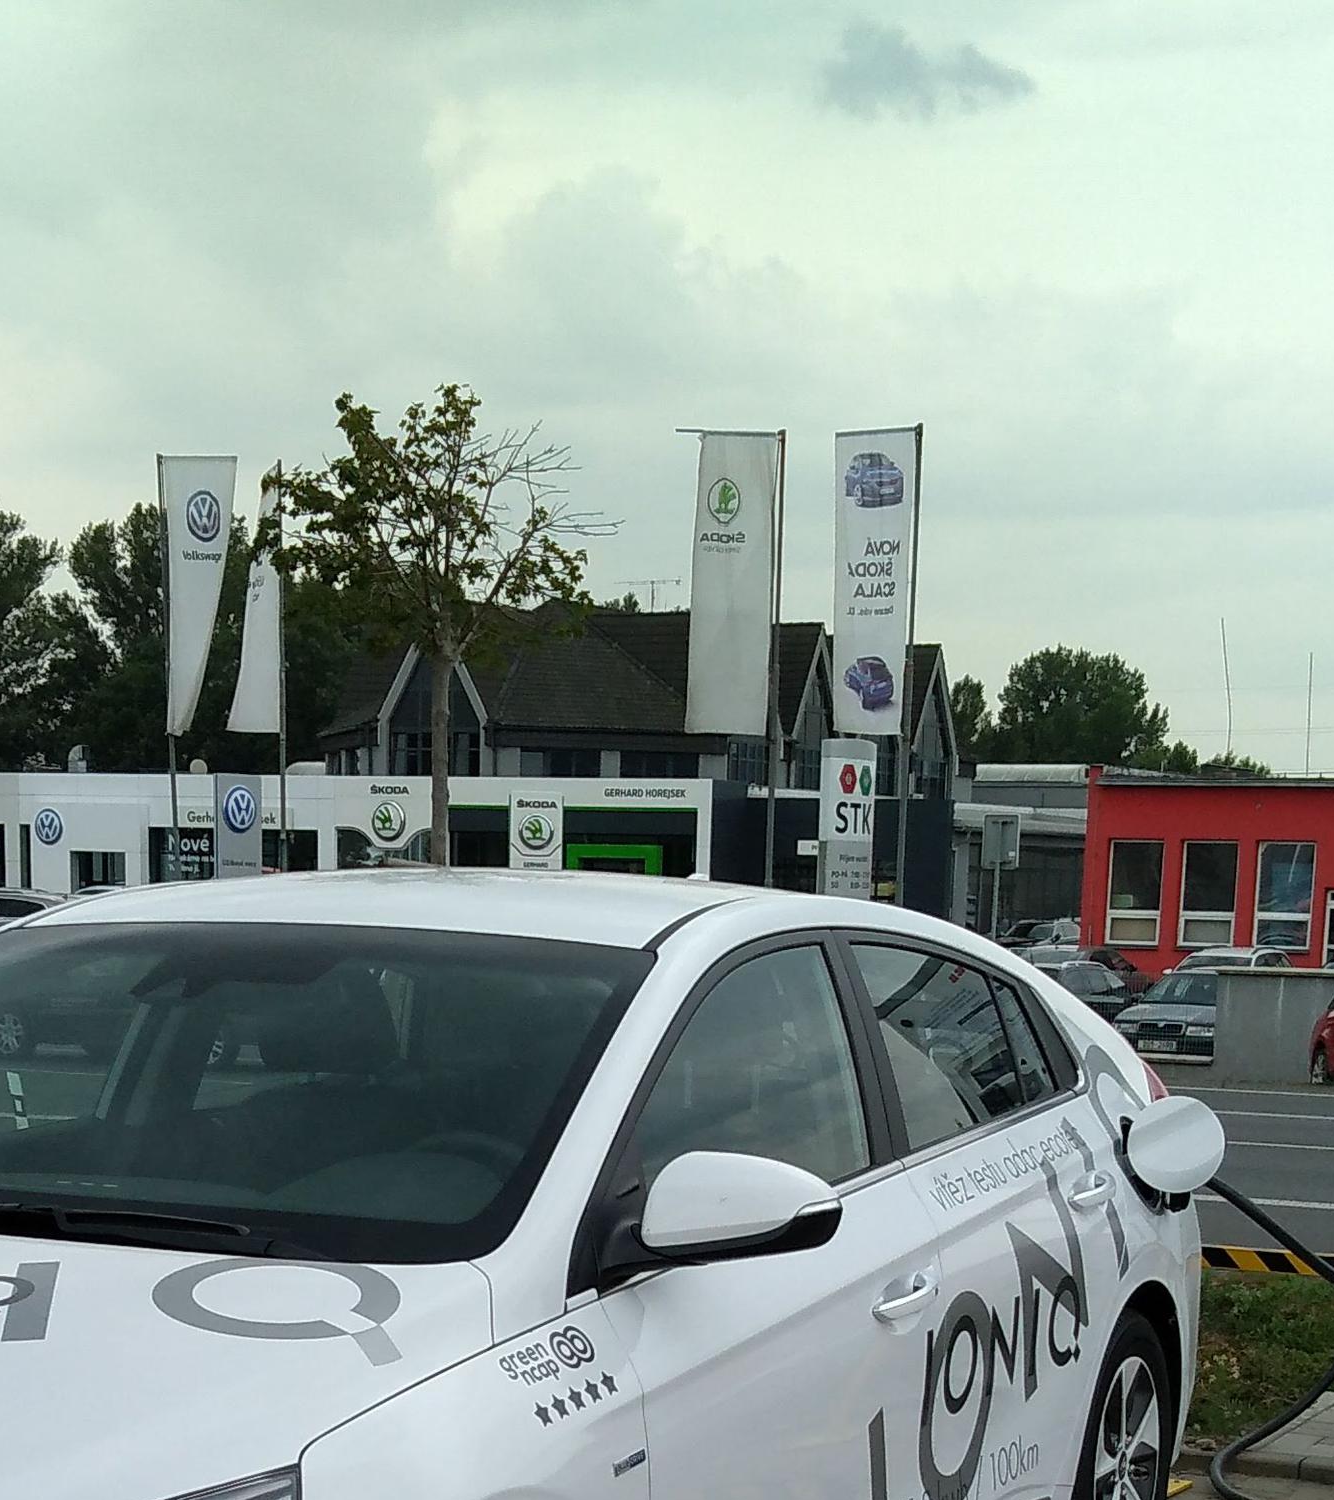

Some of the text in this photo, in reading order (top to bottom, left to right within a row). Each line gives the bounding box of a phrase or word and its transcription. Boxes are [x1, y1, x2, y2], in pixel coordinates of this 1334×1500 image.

[370, 784, 410, 795] ŠKODA
[516, 799, 558, 809] ŠKODA
[604, 788, 686, 799] GERHARD HOREJSEK
[187, 811, 215, 823] Gerh
[835, 801, 872, 835] STK
[963, 1158, 1008, 1195] testu
[1003, 1137, 1045, 1178] adac
[498, 1342, 550, 1380] green
[920, 1275, 1081, 1427] IONIQ
[519, 1358, 560, 1386] ncap
[989, 1435, 1039, 1491] 100km
